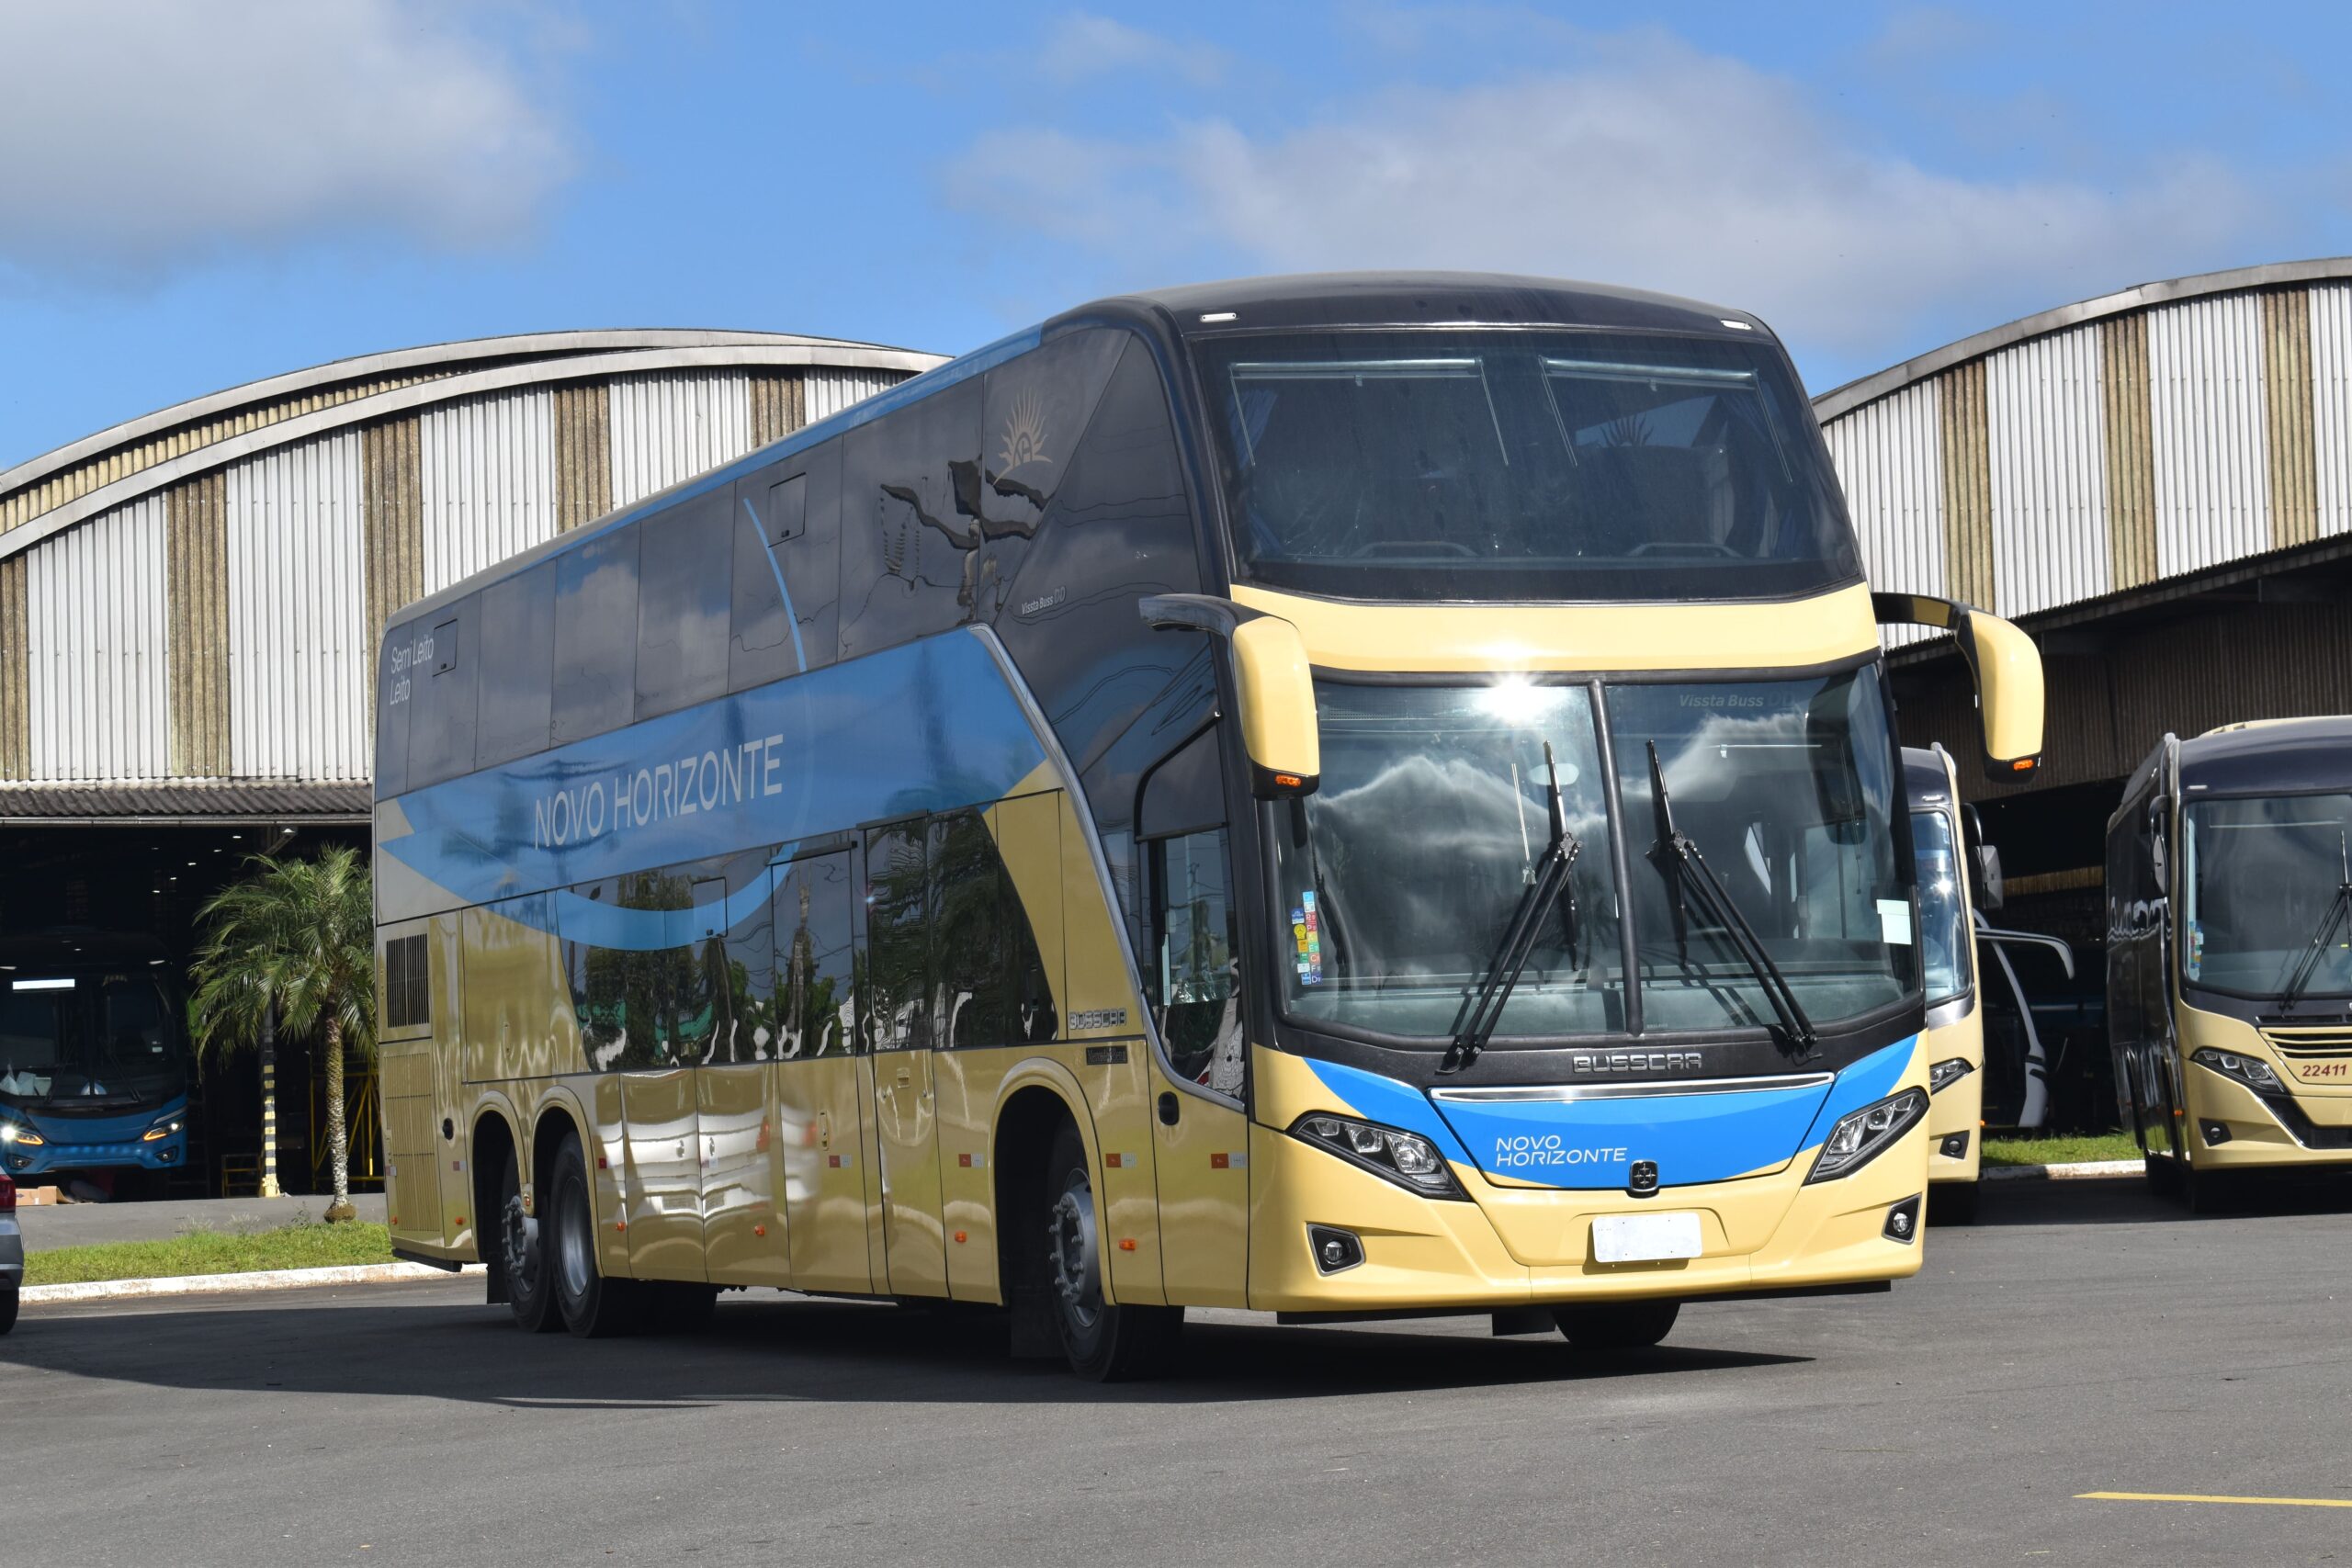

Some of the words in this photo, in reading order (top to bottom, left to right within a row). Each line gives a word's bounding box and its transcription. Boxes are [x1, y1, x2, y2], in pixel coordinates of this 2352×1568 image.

[1039, 596, 1054, 609] Buss
[390, 639, 413, 674] Semi
[413, 634, 434, 665] Leito
[390, 675, 411, 705] Leito
[1679, 694, 1724, 707] Vissta
[1727, 694, 1764, 707] Buss
[535, 781, 605, 851] NOVO
[613, 733, 784, 831] HORIZONTE
[1573, 1053, 1702, 1073] BUSSCAR
[2301, 1064, 2347, 1077] 22411
[1496, 1134, 1561, 1152] NOVO
[1496, 1147, 1628, 1168] HORIZONTE
